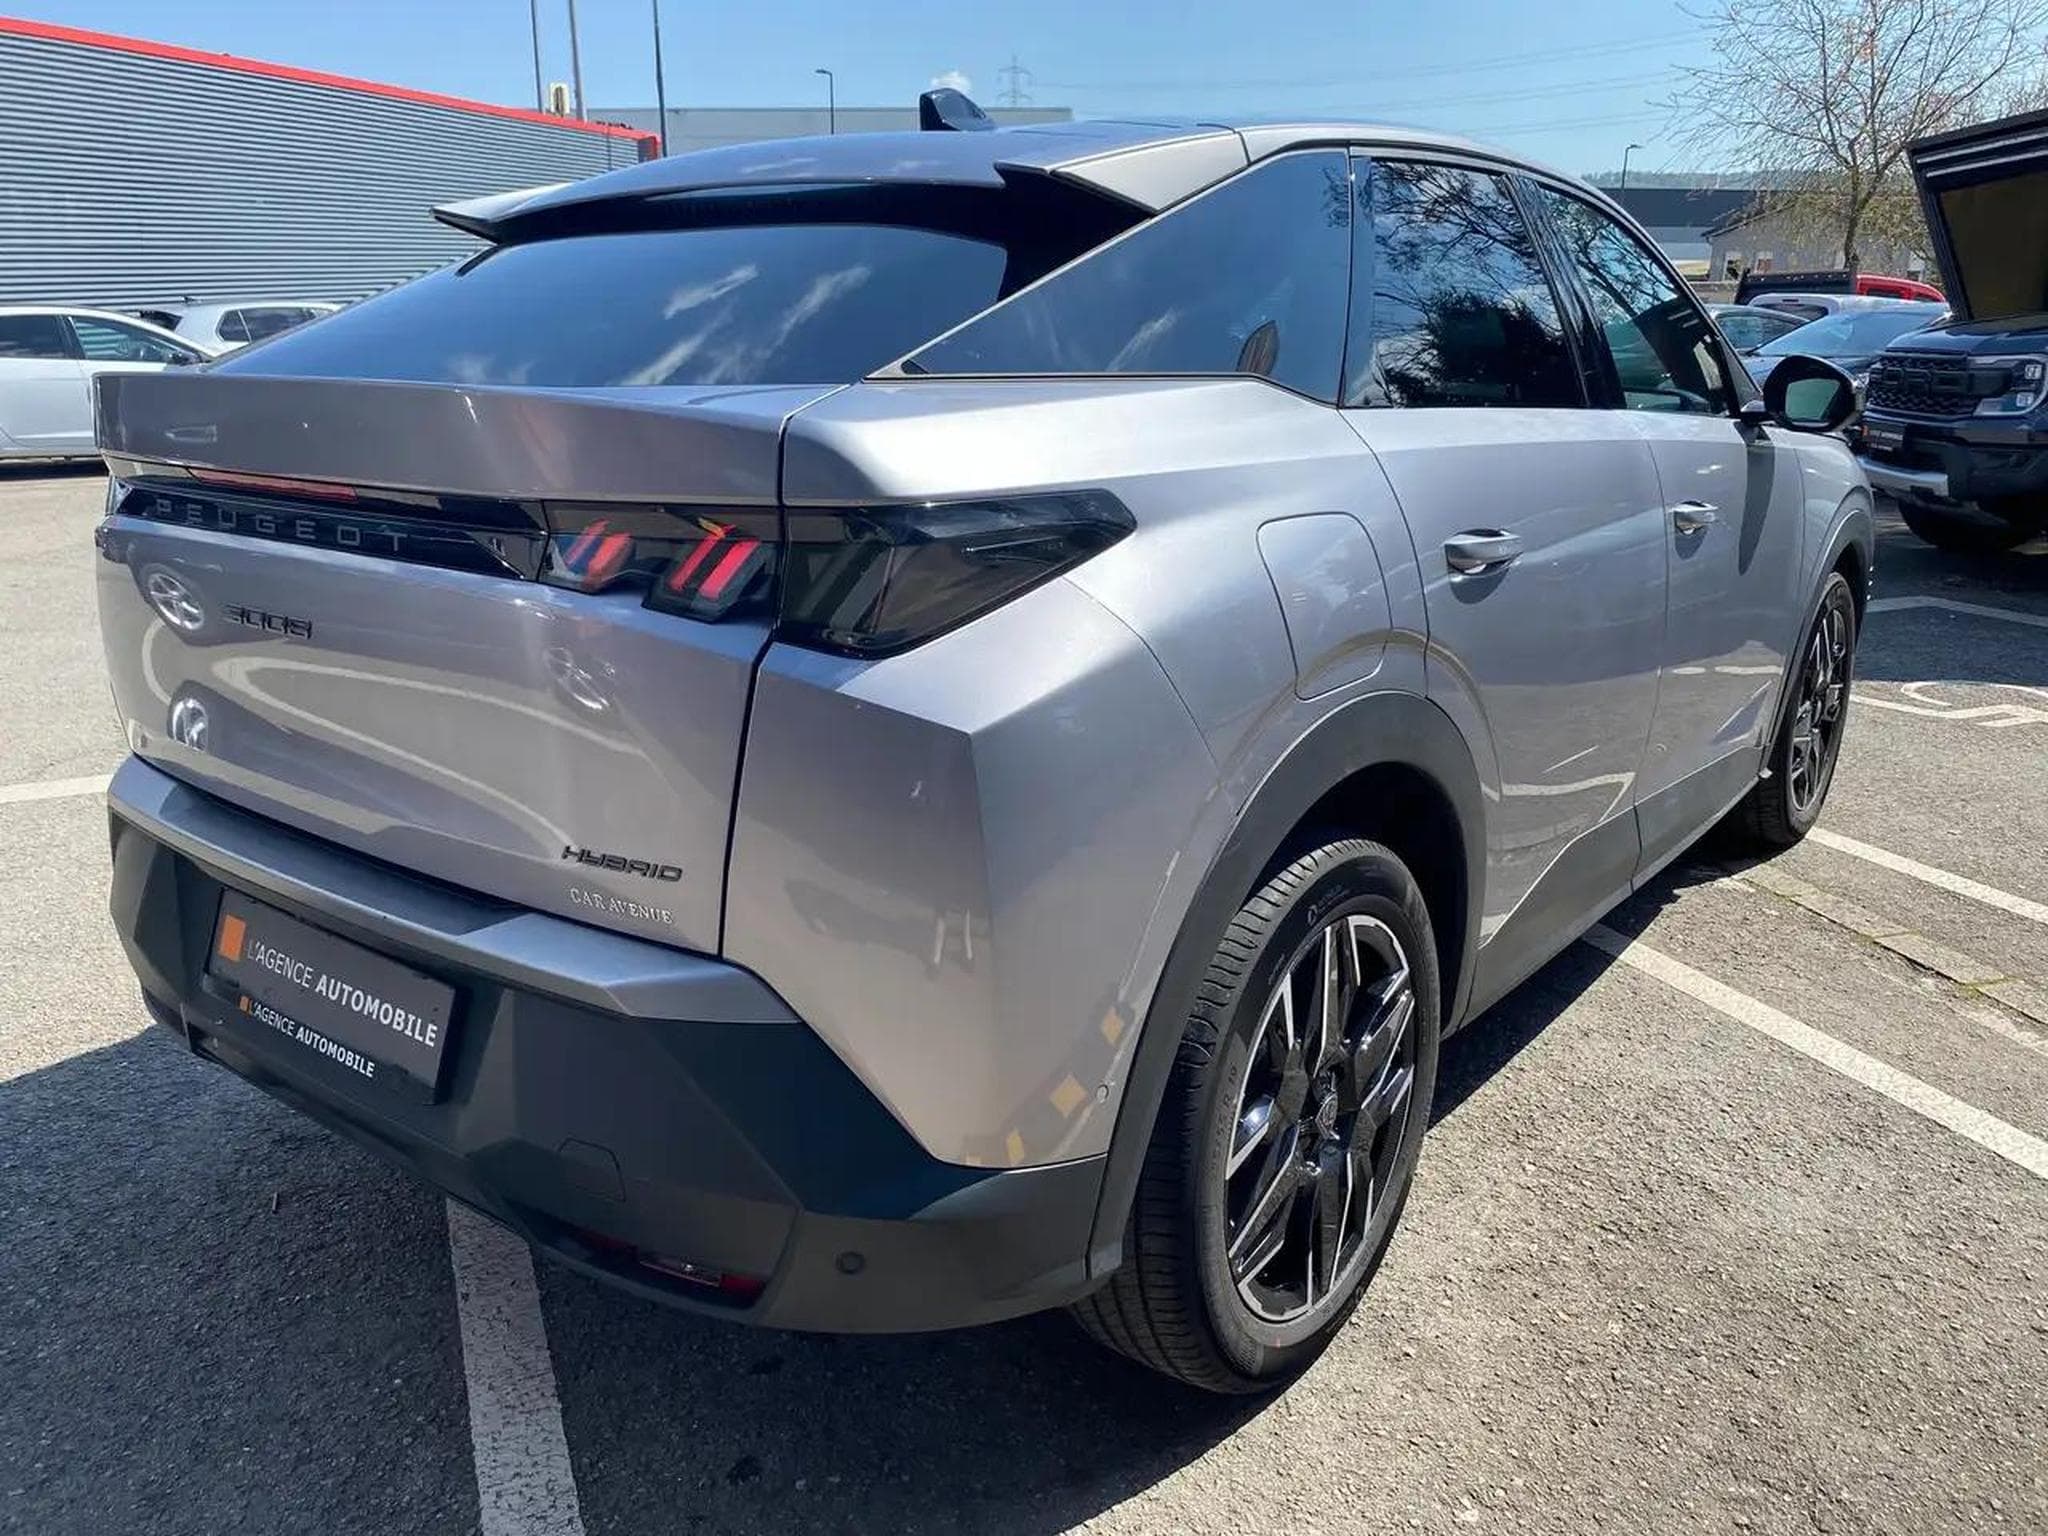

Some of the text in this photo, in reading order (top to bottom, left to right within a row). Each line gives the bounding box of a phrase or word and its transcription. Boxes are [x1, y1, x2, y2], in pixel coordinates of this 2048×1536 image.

[156, 499, 408, 552] PEUGEOT
[224, 603, 313, 639] 3008
[561, 845, 684, 882] HYBRID
[569, 888, 674, 924] CAR AVENUE
[247, 939, 439, 1047] L'AGENCE AUTOMOBILE
[250, 1000, 376, 1078] L'AGENCE AUTOMOBILE
